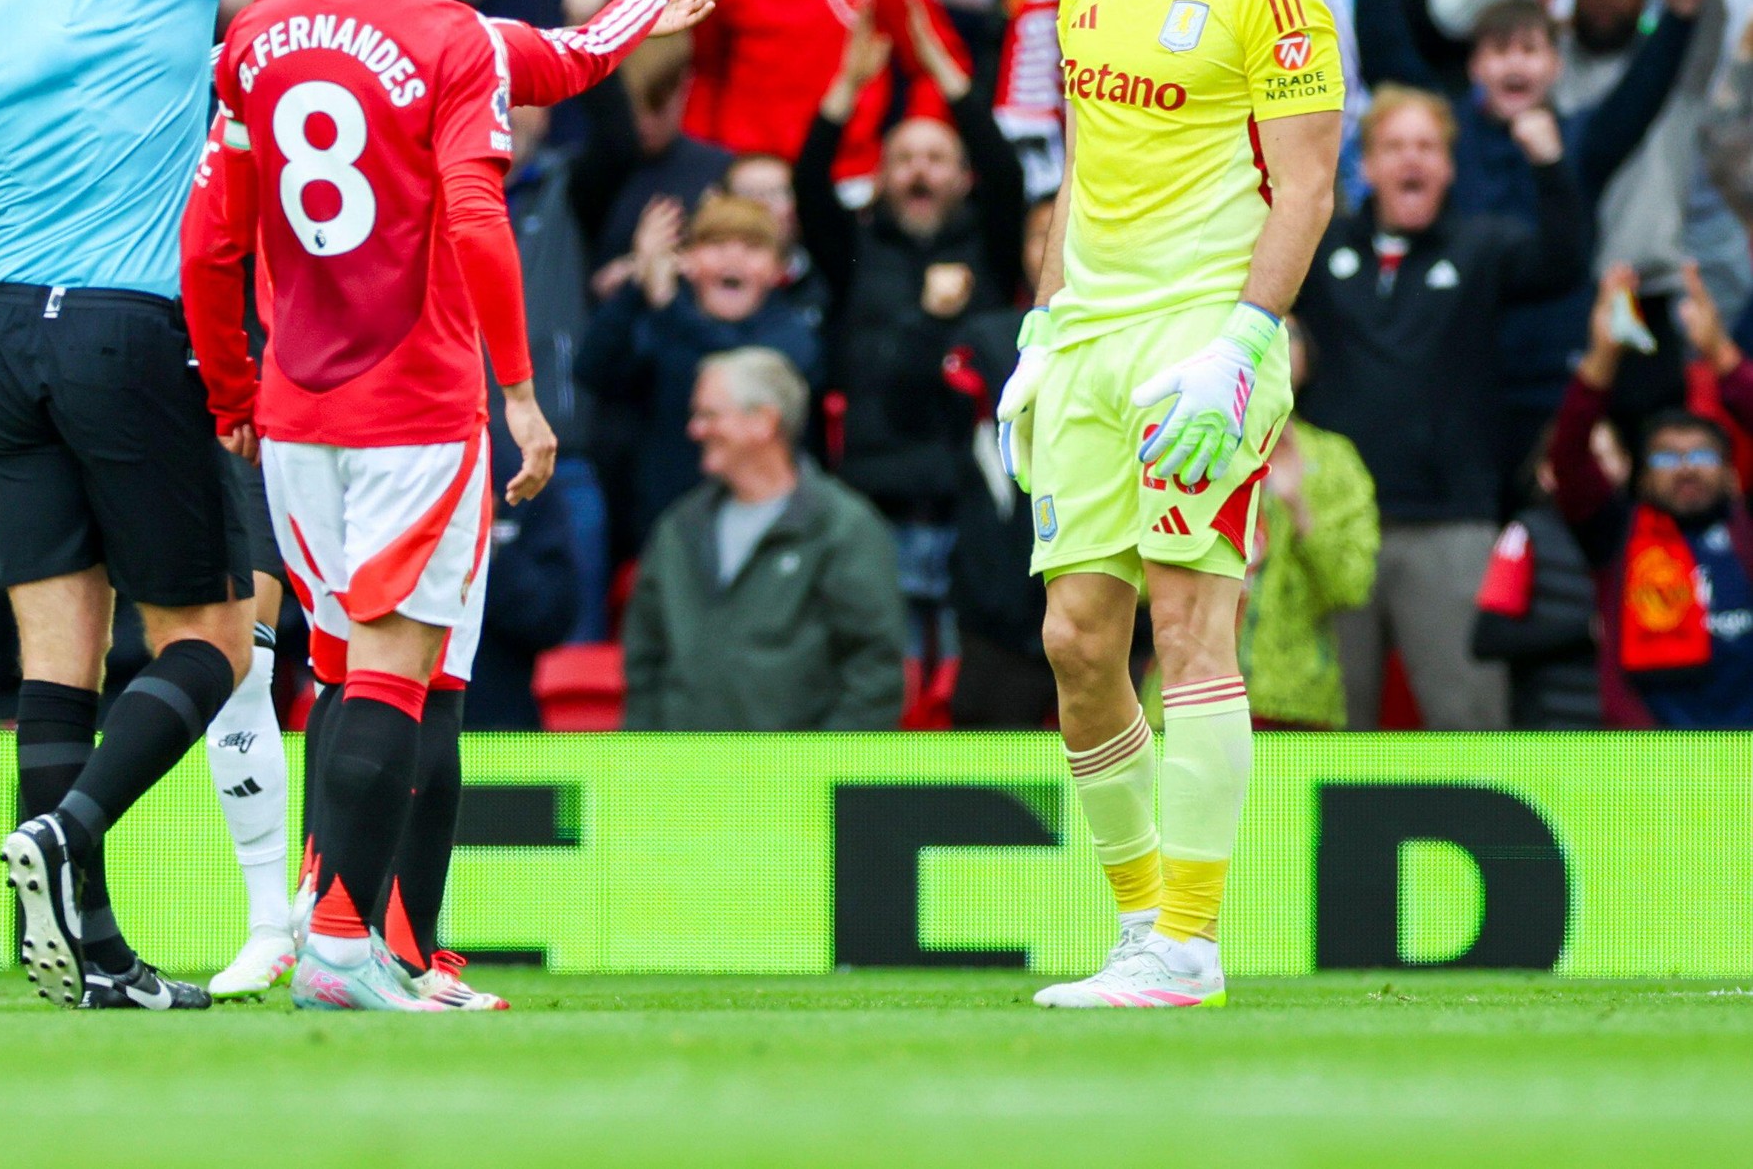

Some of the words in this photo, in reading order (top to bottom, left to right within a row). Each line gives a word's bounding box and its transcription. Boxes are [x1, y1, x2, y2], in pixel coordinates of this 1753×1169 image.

[1266, 71, 1325, 89] TRADE
[1266, 85, 1327, 101] NATION
[272, 80, 377, 257] 8
